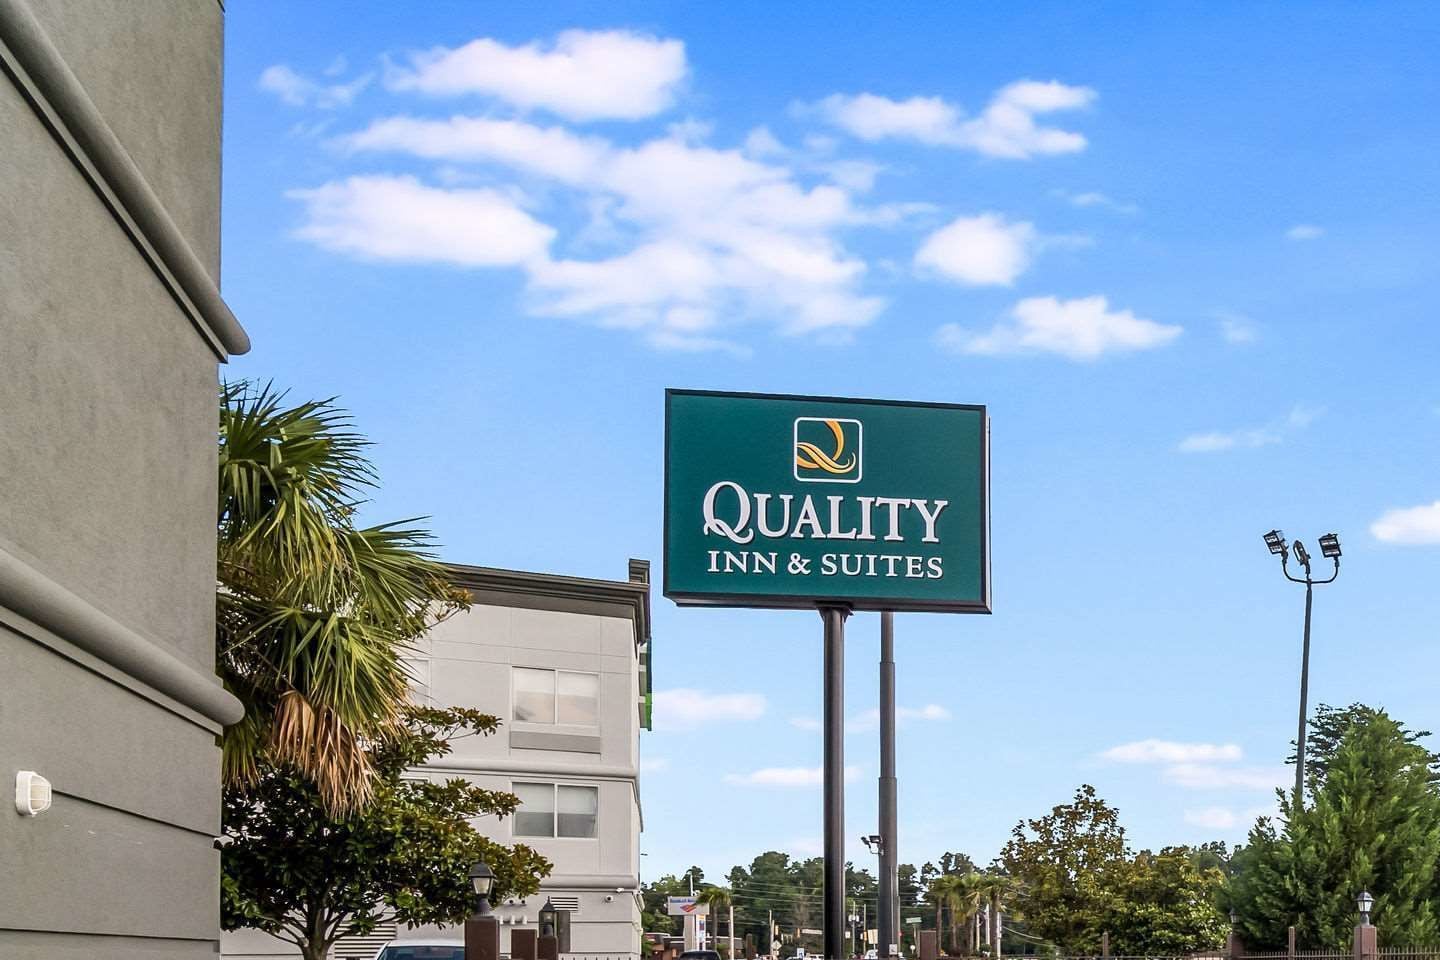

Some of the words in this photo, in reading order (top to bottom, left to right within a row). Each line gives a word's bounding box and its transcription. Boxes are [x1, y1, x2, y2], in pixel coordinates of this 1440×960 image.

[703, 481, 949, 544] QUALITY
[707, 550, 778, 574] INN
[787, 552, 811, 575] &
[820, 553, 944, 579] SUITES
